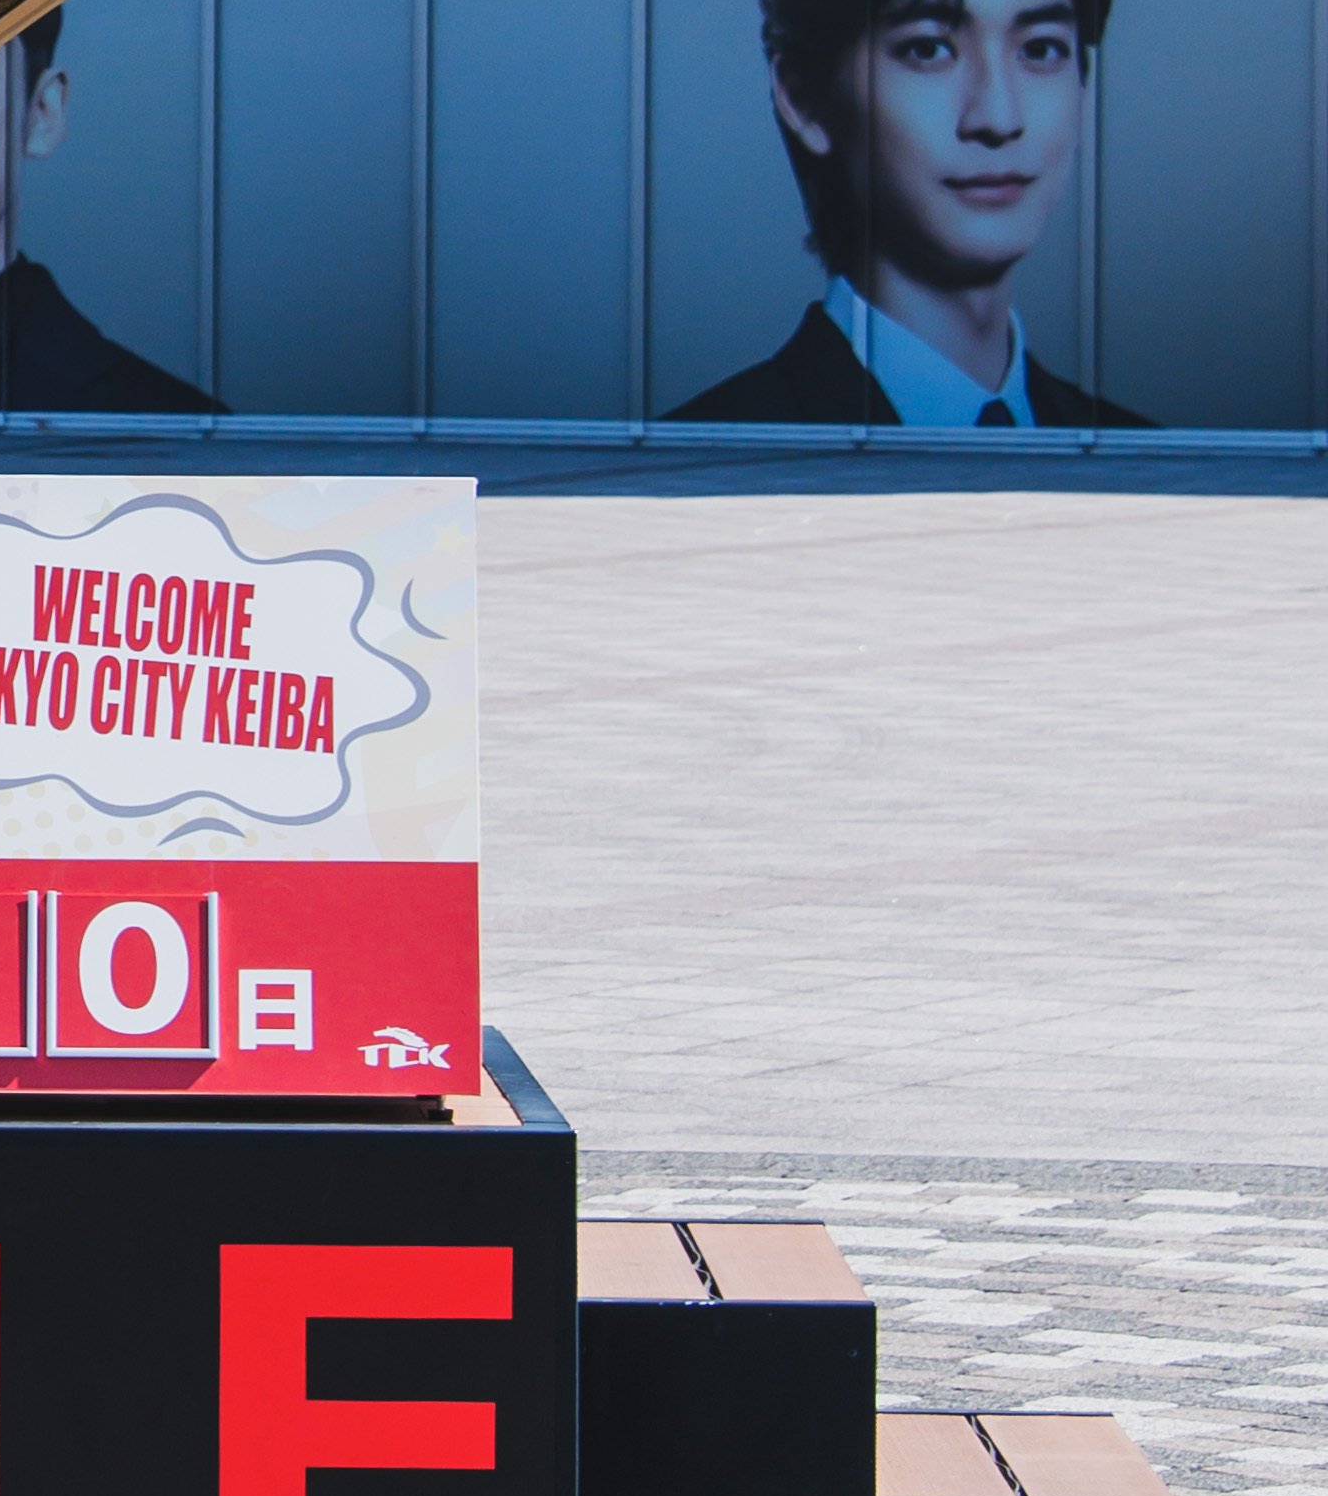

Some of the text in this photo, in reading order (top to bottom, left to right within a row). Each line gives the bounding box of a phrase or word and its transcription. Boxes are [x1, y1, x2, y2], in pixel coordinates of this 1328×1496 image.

[33, 564, 255, 661] WELCOME
[90, 655, 196, 741] CITY
[202, 666, 335, 754] KEIBA
[357, 1043, 451, 1069] TCK
